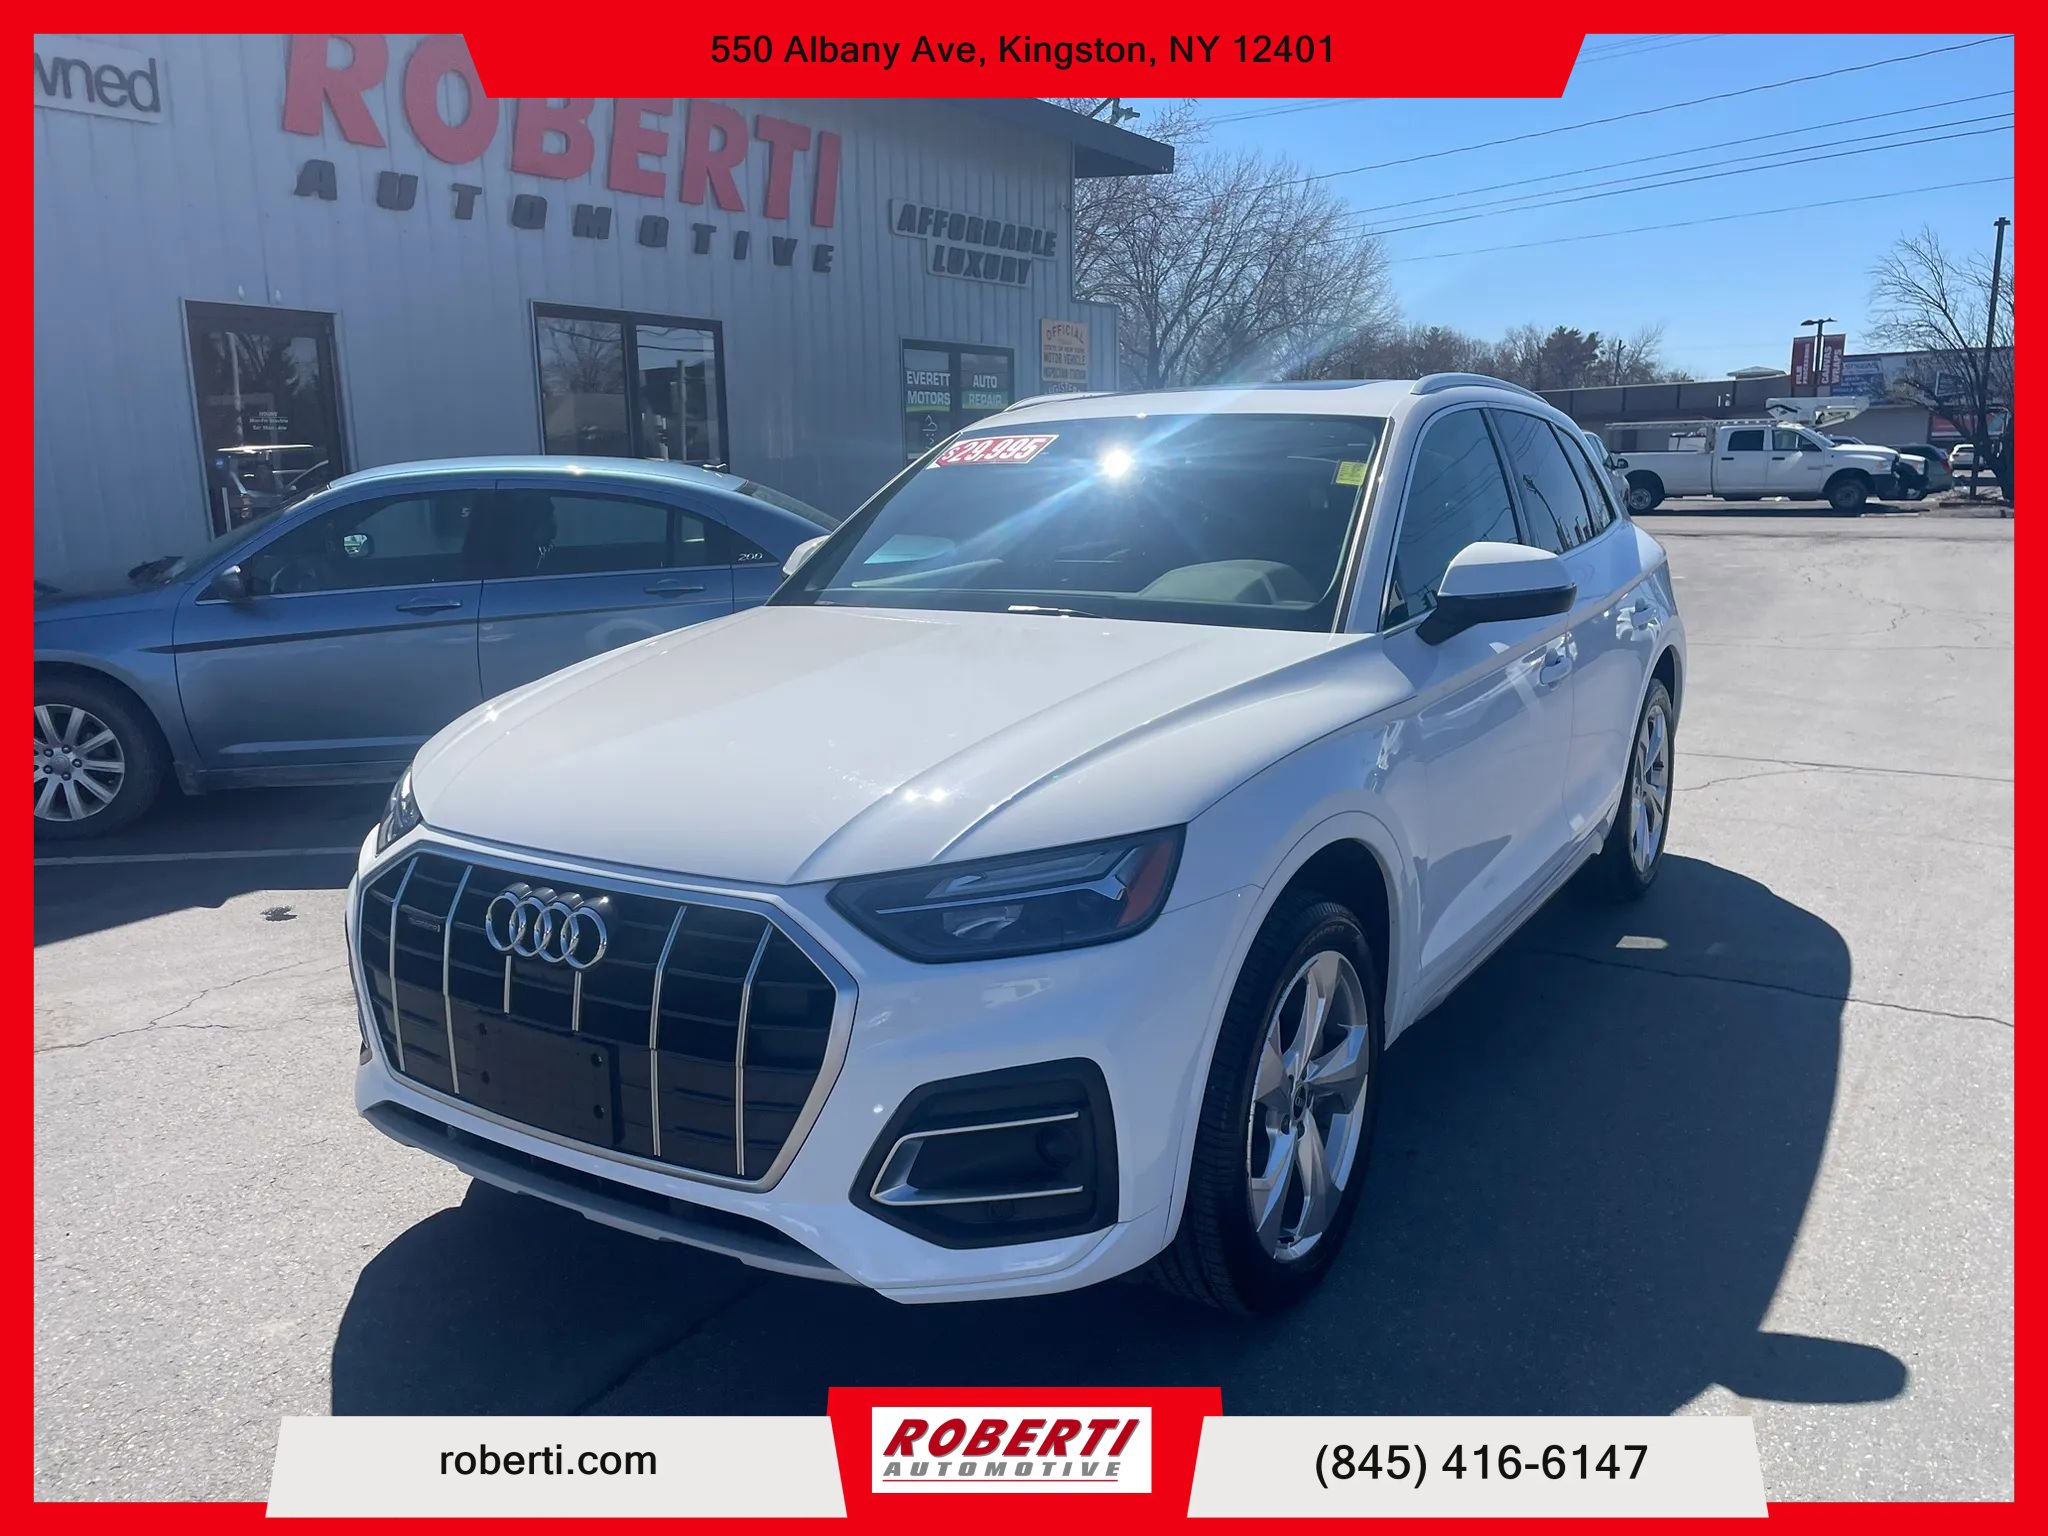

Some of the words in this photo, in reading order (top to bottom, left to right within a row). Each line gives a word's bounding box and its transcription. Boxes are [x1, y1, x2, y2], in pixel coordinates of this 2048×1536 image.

[282, 34, 842, 228] ROBERTI
[293, 158, 836, 274] AUTOMOTIVE
[897, 203, 1058, 257] AFFORDABLE
[932, 244, 1033, 285] LUXURY
[1046, 324, 1084, 344] OFFICIAL
[1043, 351, 1062, 364] MOTOR
[1064, 352, 1086, 366] VEHICLE
[1821, 346, 1832, 384] CANVAS
[1832, 349, 1842, 384] WRAPS
[906, 370, 951, 387] EVERETT
[972, 374, 998, 389] AUTO
[907, 390, 951, 406] MOTORS
[968, 393, 1003, 406] REPAIR
[941, 438, 1048, 463] $29,995
[738, 552, 763, 561] 200
